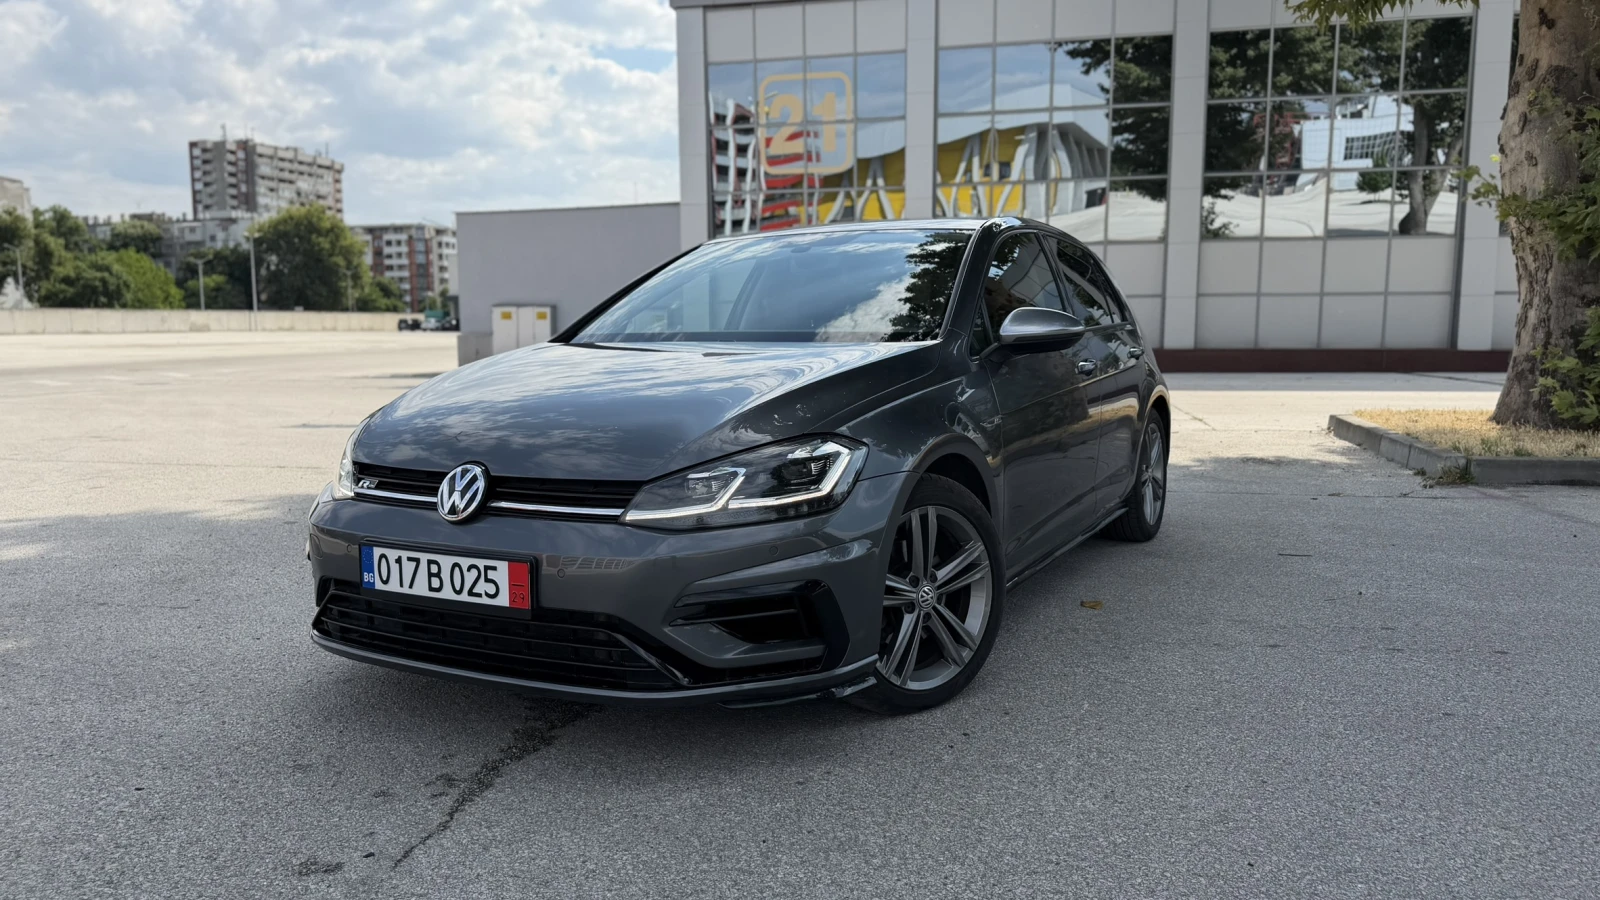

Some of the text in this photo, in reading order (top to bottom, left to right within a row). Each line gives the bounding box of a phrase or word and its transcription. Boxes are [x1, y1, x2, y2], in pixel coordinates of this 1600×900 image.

[769, 91, 837, 154] 21
[363, 572, 374, 583] BG
[377, 553, 500, 600] 017 B 025
[511, 591, 525, 604] 29
